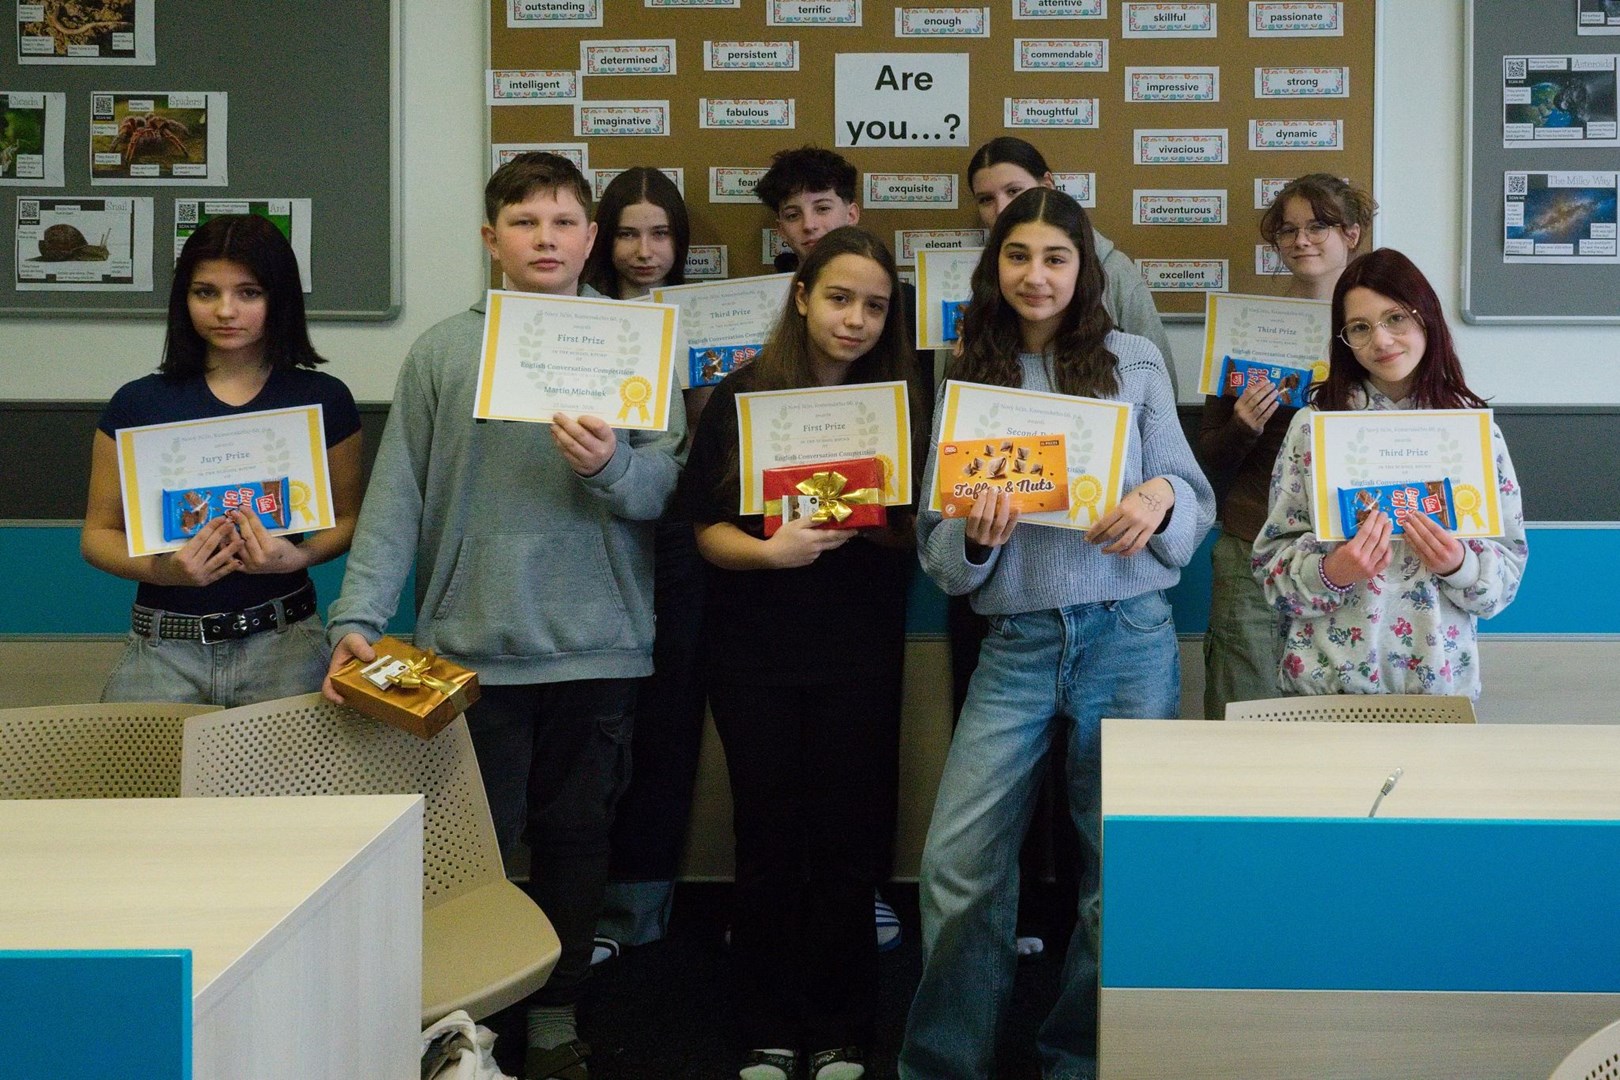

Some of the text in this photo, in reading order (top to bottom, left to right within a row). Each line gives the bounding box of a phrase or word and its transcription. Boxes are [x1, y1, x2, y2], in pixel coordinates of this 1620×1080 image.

[525, 2, 585, 13] outstanding
[798, 5, 831, 14] terrific
[924, 17, 961, 28] enough
[1153, 12, 1186, 22] skillful
[1270, 13, 1323, 24] passionate
[600, 54, 658, 65] determined
[728, 50, 778, 61] persistent
[1031, 50, 1093, 60] commendable
[1574, 59, 1613, 69] Asteroids
[875, 65, 933, 91] Are
[1287, 77, 1319, 89] strong
[509, 79, 560, 91] intelligent
[1146, 82, 1199, 93] impressive
[9, 97, 39, 108] Cicada
[169, 96, 202, 107] Spiders
[726, 107, 769, 117] fabulous
[1026, 106, 1078, 118] thoughtful
[593, 115, 651, 127] imaginative
[846, 113, 961, 146] you...?
[1276, 129, 1318, 140] dynamic
[1158, 144, 1205, 154] vivacious
[1549, 175, 1612, 187] The Milky Way
[888, 184, 934, 194] exquisite
[105, 201, 128, 212] Snail
[1150, 205, 1212, 214] adventurous
[1159, 270, 1205, 280] excellent
[710, 308, 752, 319] Third Prize
[1257, 326, 1297, 336] Third Prize
[557, 334, 605, 345] First Prize
[520, 361, 635, 376] English Conversation Competition
[544, 386, 570, 394] Martin
[803, 422, 846, 432] First Prize
[1006, 427, 1038, 437] Second
[200, 452, 250, 464] Jury Prize
[775, 449, 876, 462] English Conversation Competition
[1379, 448, 1429, 457] Third Prize
[1004, 480, 1014, 493] &
[1016, 478, 1054, 493] Nuts
[1350, 479, 1374, 487] English
